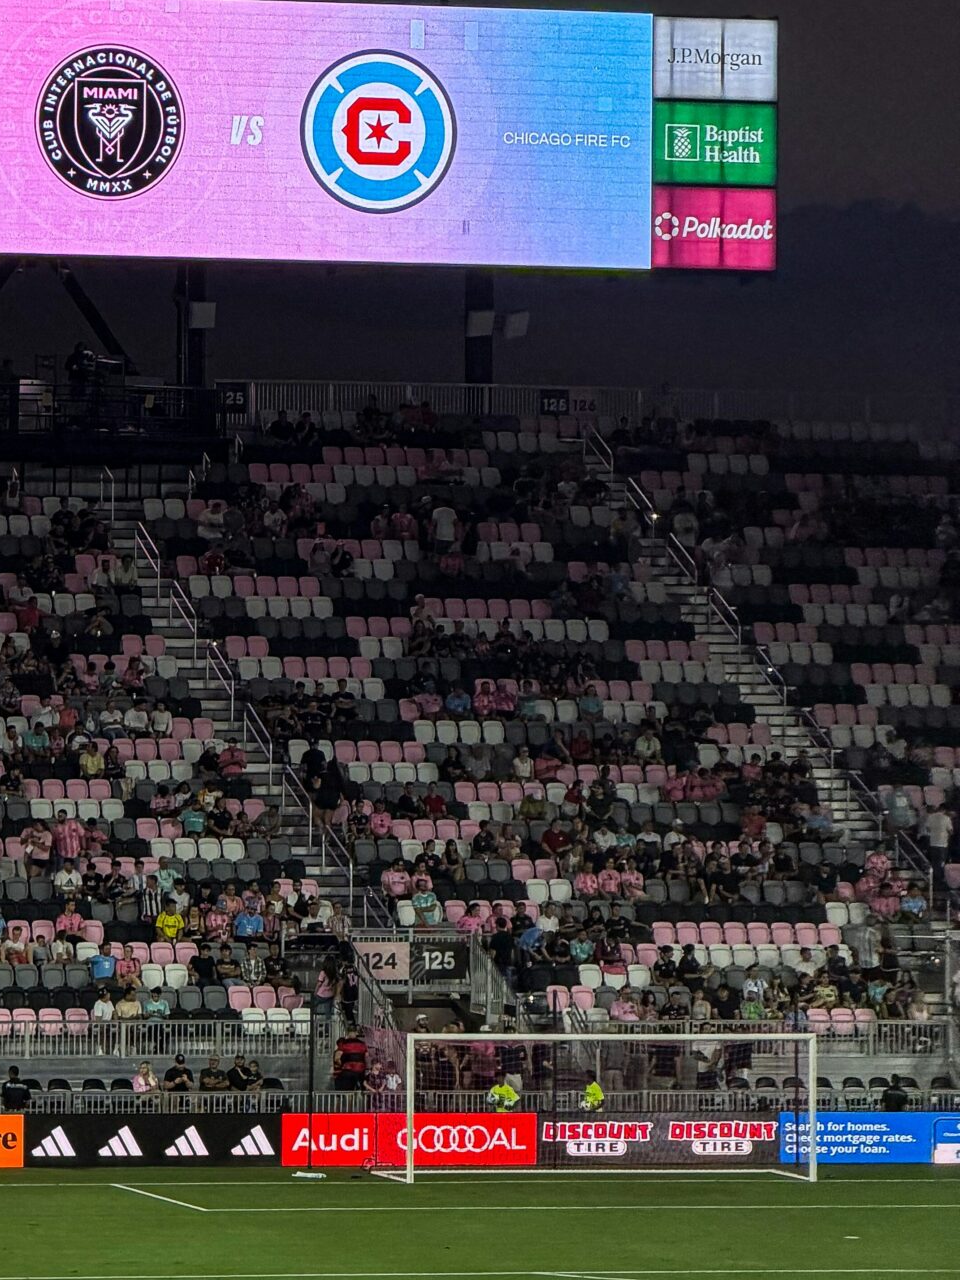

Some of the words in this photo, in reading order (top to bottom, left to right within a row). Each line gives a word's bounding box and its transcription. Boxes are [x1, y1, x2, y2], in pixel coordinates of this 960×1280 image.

[44, 52, 155, 112] INTERNACIONAL
[155, 81, 172, 100] DE
[83, 87, 138, 100] MIAMI
[155, 106, 180, 163] FÚTBOL
[231, 115, 265, 145] VS
[503, 131, 572, 146] CHICAGO
[575, 134, 607, 147] FIRE
[611, 135, 631, 148] FC
[705, 125, 764, 148] Baptist
[43, 120, 62, 160] CLUB
[704, 145, 760, 164] Health
[86, 178, 132, 192] MMXX
[682, 216, 773, 240] Polkadot
[363, 952, 397, 970] 124
[422, 951, 455, 970] 125
[544, 1122, 651, 1141] DISCOUNT
[669, 1121, 776, 1140] DISCOUNT
[827, 1122, 845, 1131] for
[847, 1122, 890, 1131] homes.
[291, 1128, 369, 1151] Audi
[574, 1142, 618, 1152] TIRE
[699, 1141, 744, 1152] TIRE
[823, 1133, 880, 1144] mortgage
[883, 1134, 917, 1142] rates.
[829, 1146, 856, 1156] your
[860, 1145, 890, 1154] loan.
